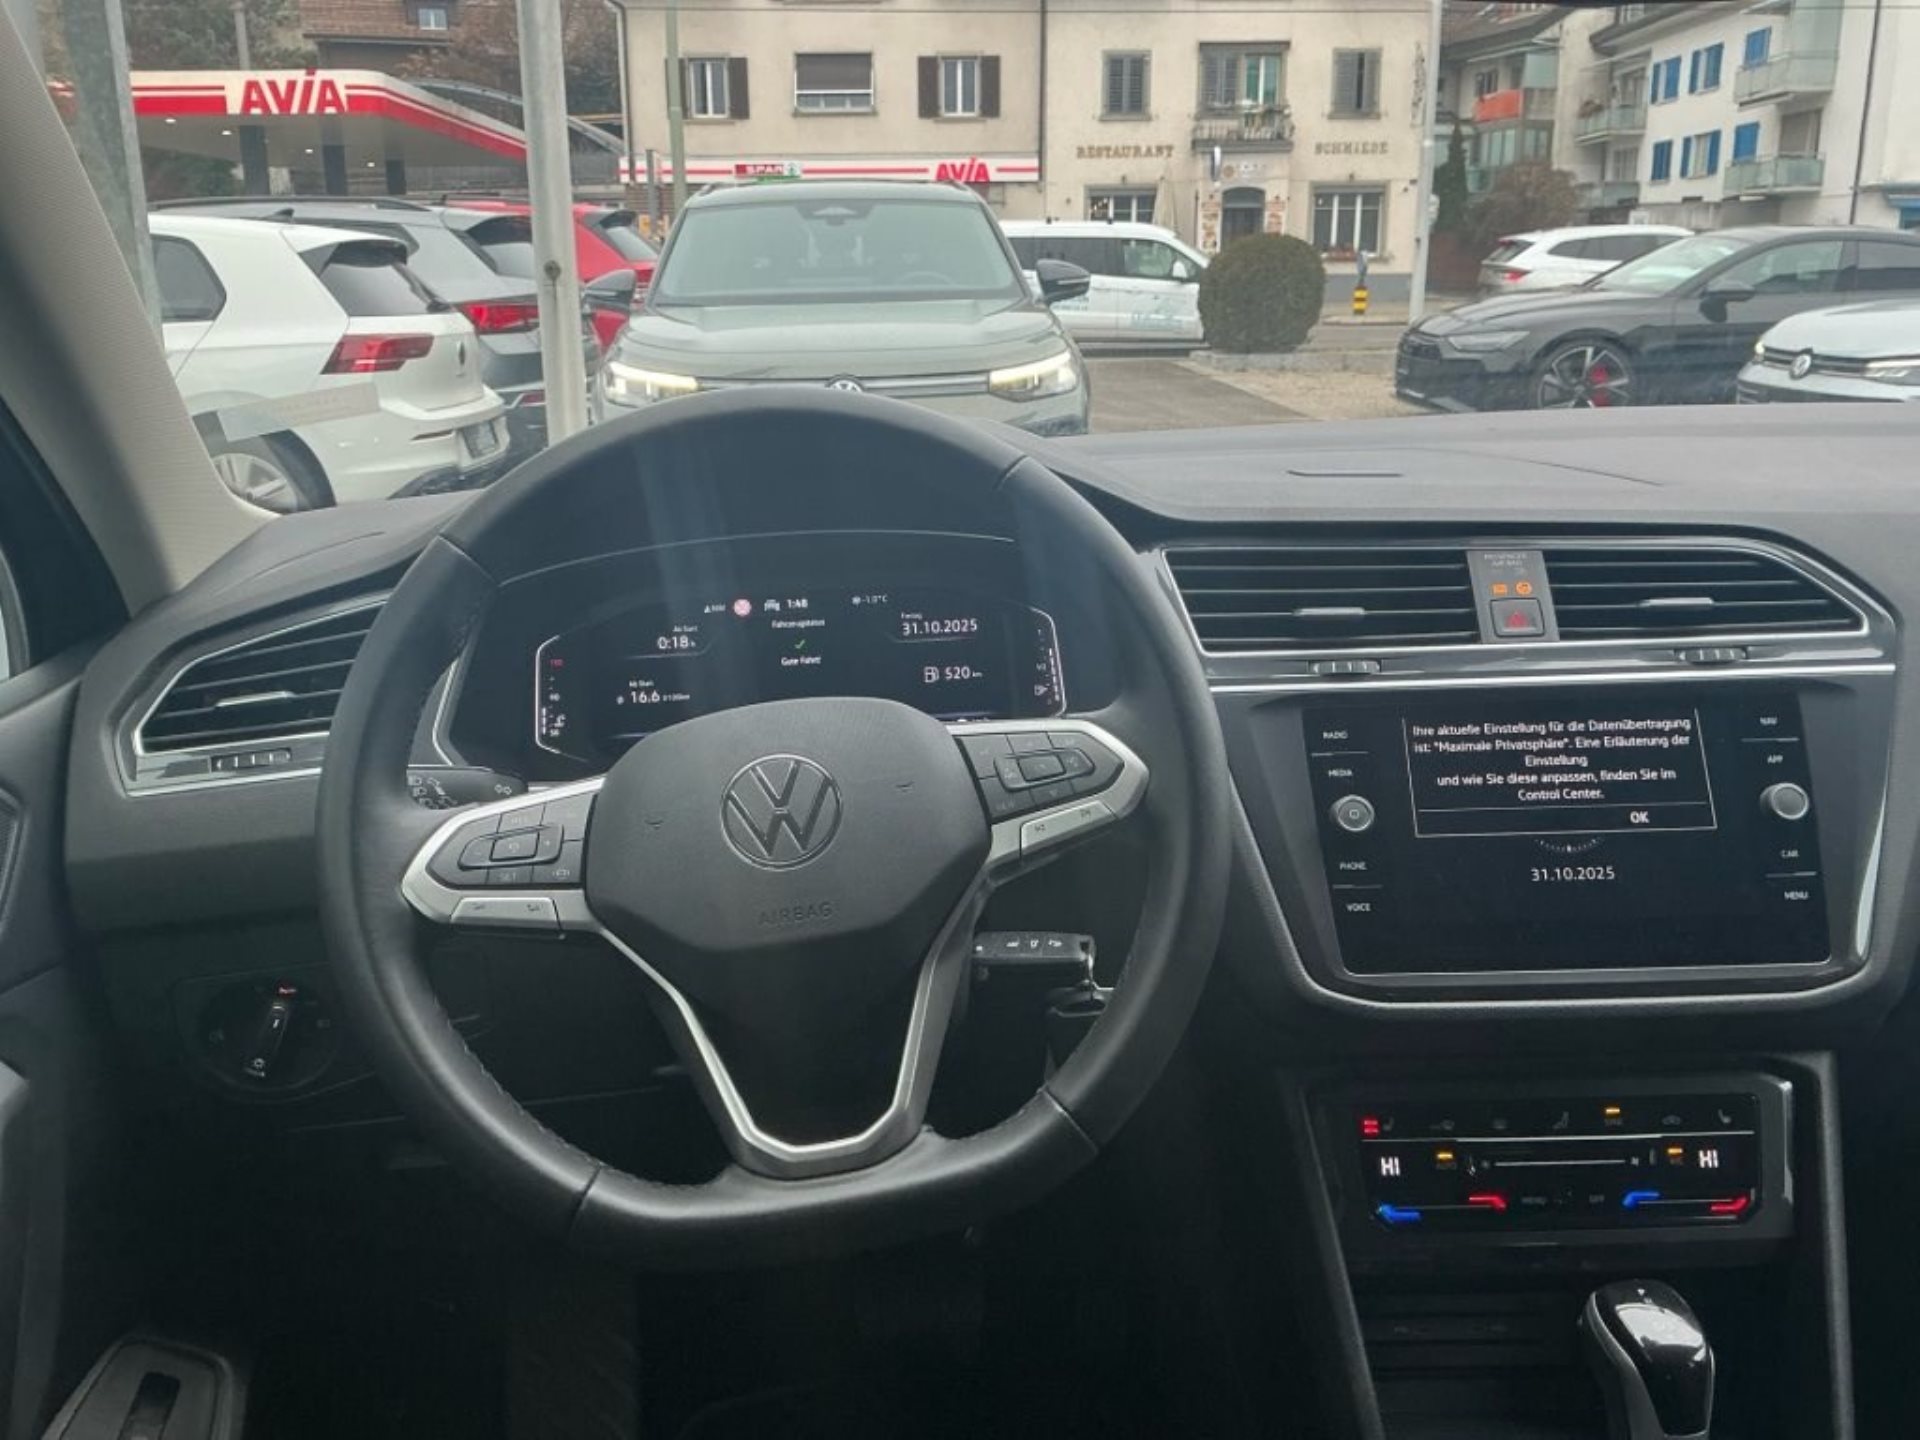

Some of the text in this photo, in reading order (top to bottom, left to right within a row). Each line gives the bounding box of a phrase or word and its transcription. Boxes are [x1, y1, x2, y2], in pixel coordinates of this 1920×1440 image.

[1076, 144, 1174, 160] RESTAURANT
[1314, 140, 1389, 156] SCHMIEDE
[902, 619, 978, 636] 31.10.2025
[658, 635, 689, 649] 0:18
[945, 666, 971, 680] 520
[1412, 718, 1692, 736] Ihre aktuelle Einstellung für die Datenübertragung
[1575, 737, 1601, 749] Eine
[1603, 735, 1669, 749] Erläuterung
[1671, 735, 1690, 746] der
[1525, 755, 1588, 768] Einstellung
[1437, 768, 1677, 786] und wie Sie diese anpassen, finden Sie im
[1517, 787, 1605, 801] Control Center.
[1629, 811, 1650, 824] OK
[1530, 866, 1616, 882] 31.10.2025
[757, 901, 833, 926] AIRBAG
[1346, 902, 1371, 912] VOICE
[1379, 1155, 1401, 1177] HI
[1699, 1148, 1721, 1170] HI
